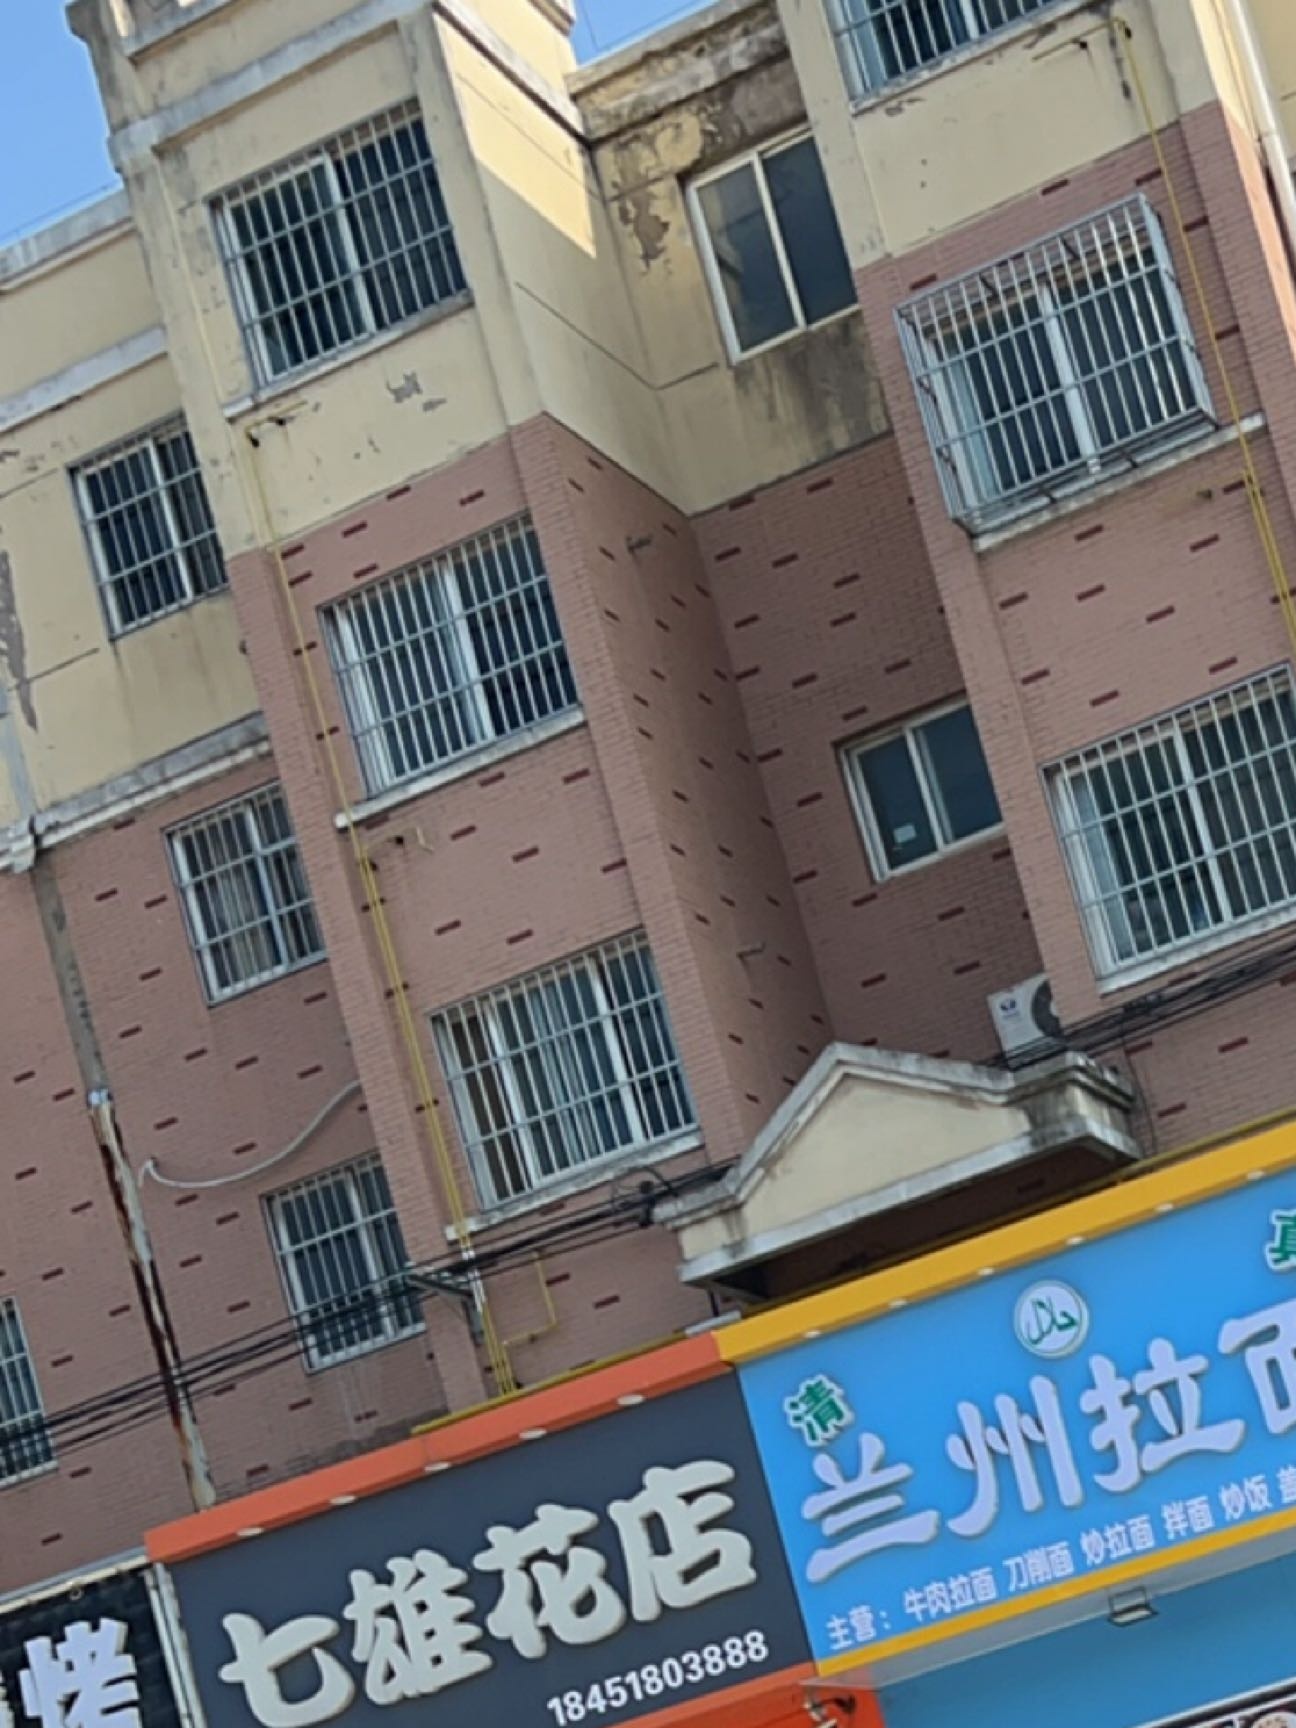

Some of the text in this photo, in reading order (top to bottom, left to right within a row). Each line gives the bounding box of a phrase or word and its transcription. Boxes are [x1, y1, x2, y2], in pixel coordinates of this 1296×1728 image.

[218, 1460, 758, 1728] 七雄花店
[904, 1566, 998, 1622] 牛肉拉面
[1002, 1541, 1075, 1592] 刀削面
[1079, 1514, 1156, 1565] 炒拉面
[1161, 1496, 1216, 1540] 拌面
[1218, 1474, 1273, 1521] 炒饭
[546, 1631, 770, 1728] 18451803888
